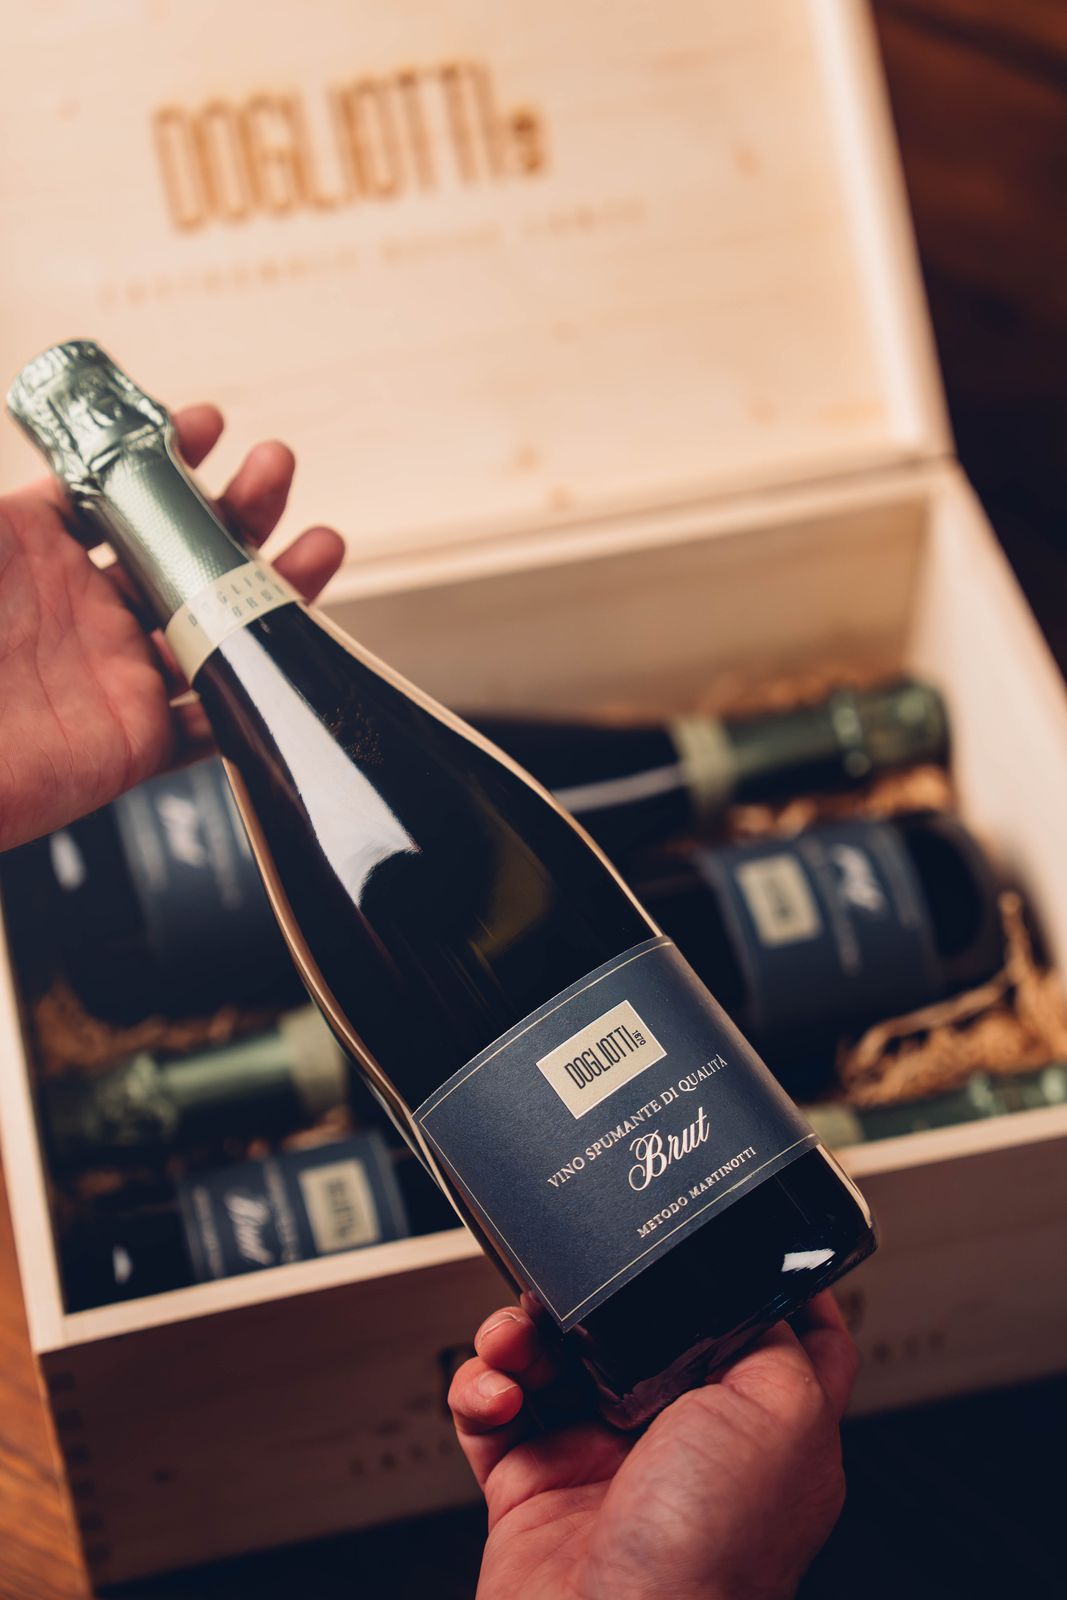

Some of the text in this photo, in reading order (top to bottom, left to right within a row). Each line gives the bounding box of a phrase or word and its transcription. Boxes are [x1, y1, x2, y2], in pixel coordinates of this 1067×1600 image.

[564, 1024, 640, 1090] DOGLIOTTI
[632, 1029, 647, 1046] 1870
[547, 1053, 728, 1189] VINO SPUMANTE DI QUALITÀ
[628, 1106, 711, 1192] Brut
[636, 1146, 757, 1239] METODO MARTINOTTI
